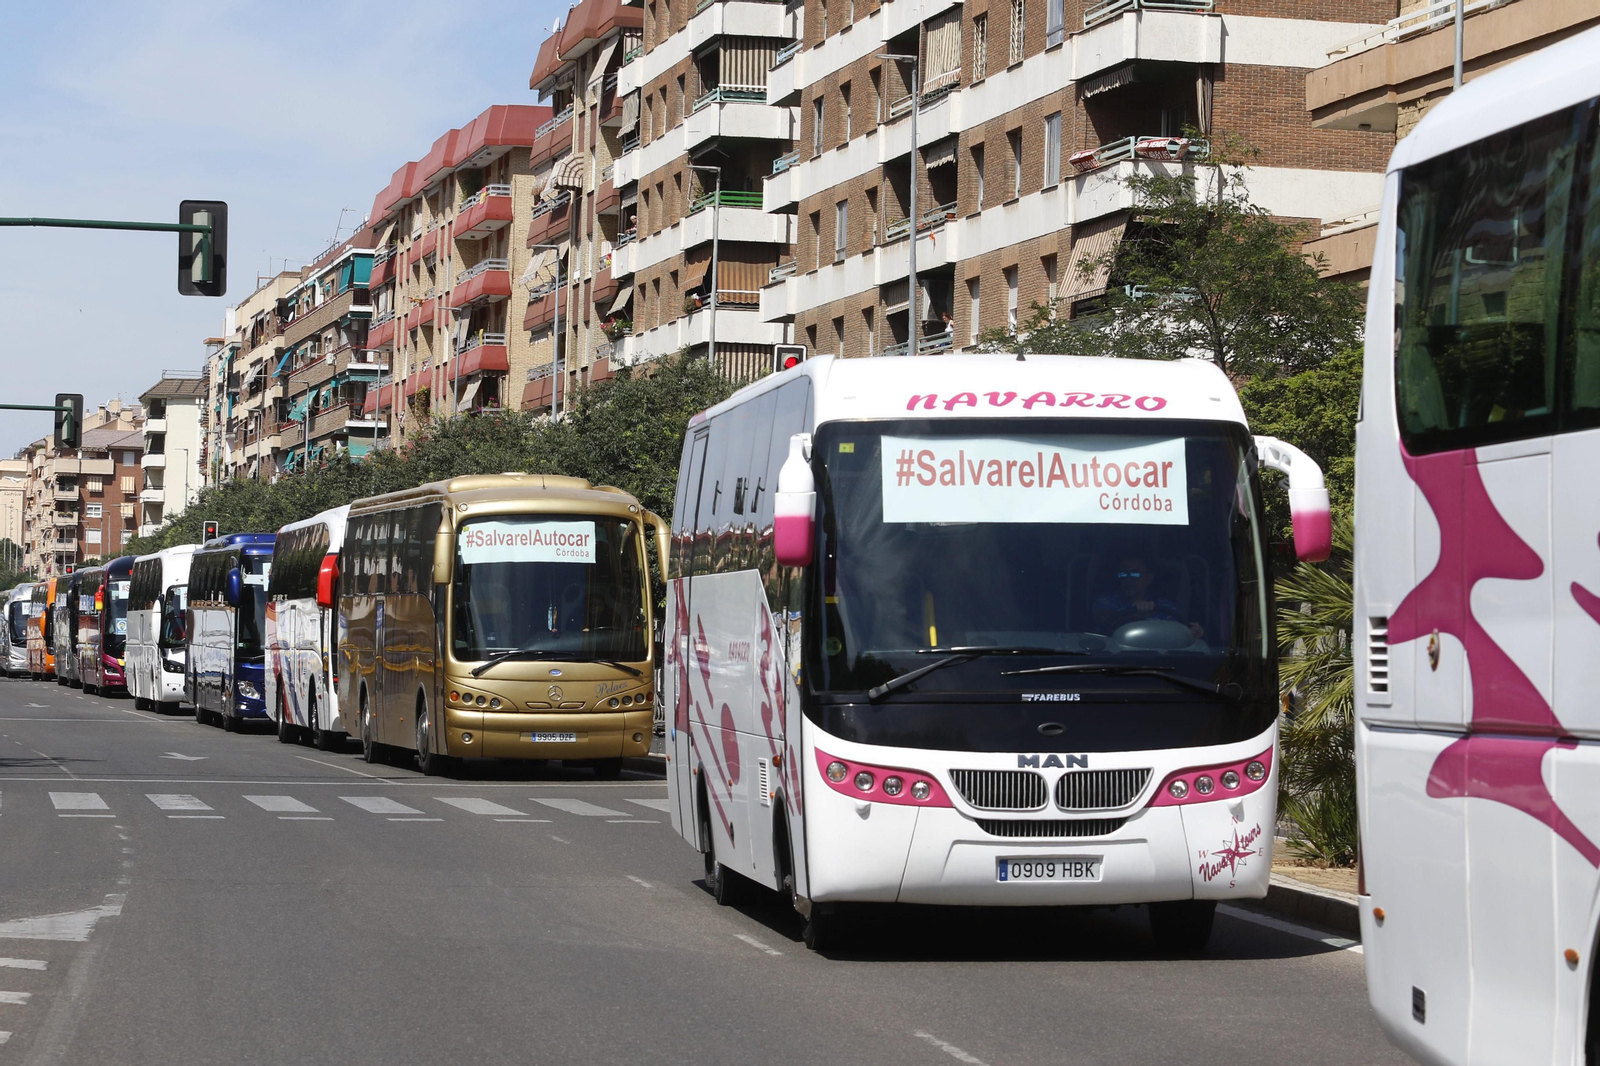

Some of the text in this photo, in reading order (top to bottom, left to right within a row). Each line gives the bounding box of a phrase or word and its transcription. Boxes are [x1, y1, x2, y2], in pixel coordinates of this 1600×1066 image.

[896, 449, 1173, 488] #SalvarelAutocar
[1099, 492, 1173, 512] Córdoba
[466, 529, 590, 548] #SalvarelAutocar
[555, 547, 590, 558] Córdoba
[1033, 693, 1081, 702] FAREBUS
[537, 733, 574, 741] 9905 DZF
[1017, 754, 1089, 769] MAN
[1011, 862, 1095, 879] 0909 HBK
[1198, 845, 1240, 883] Nava
